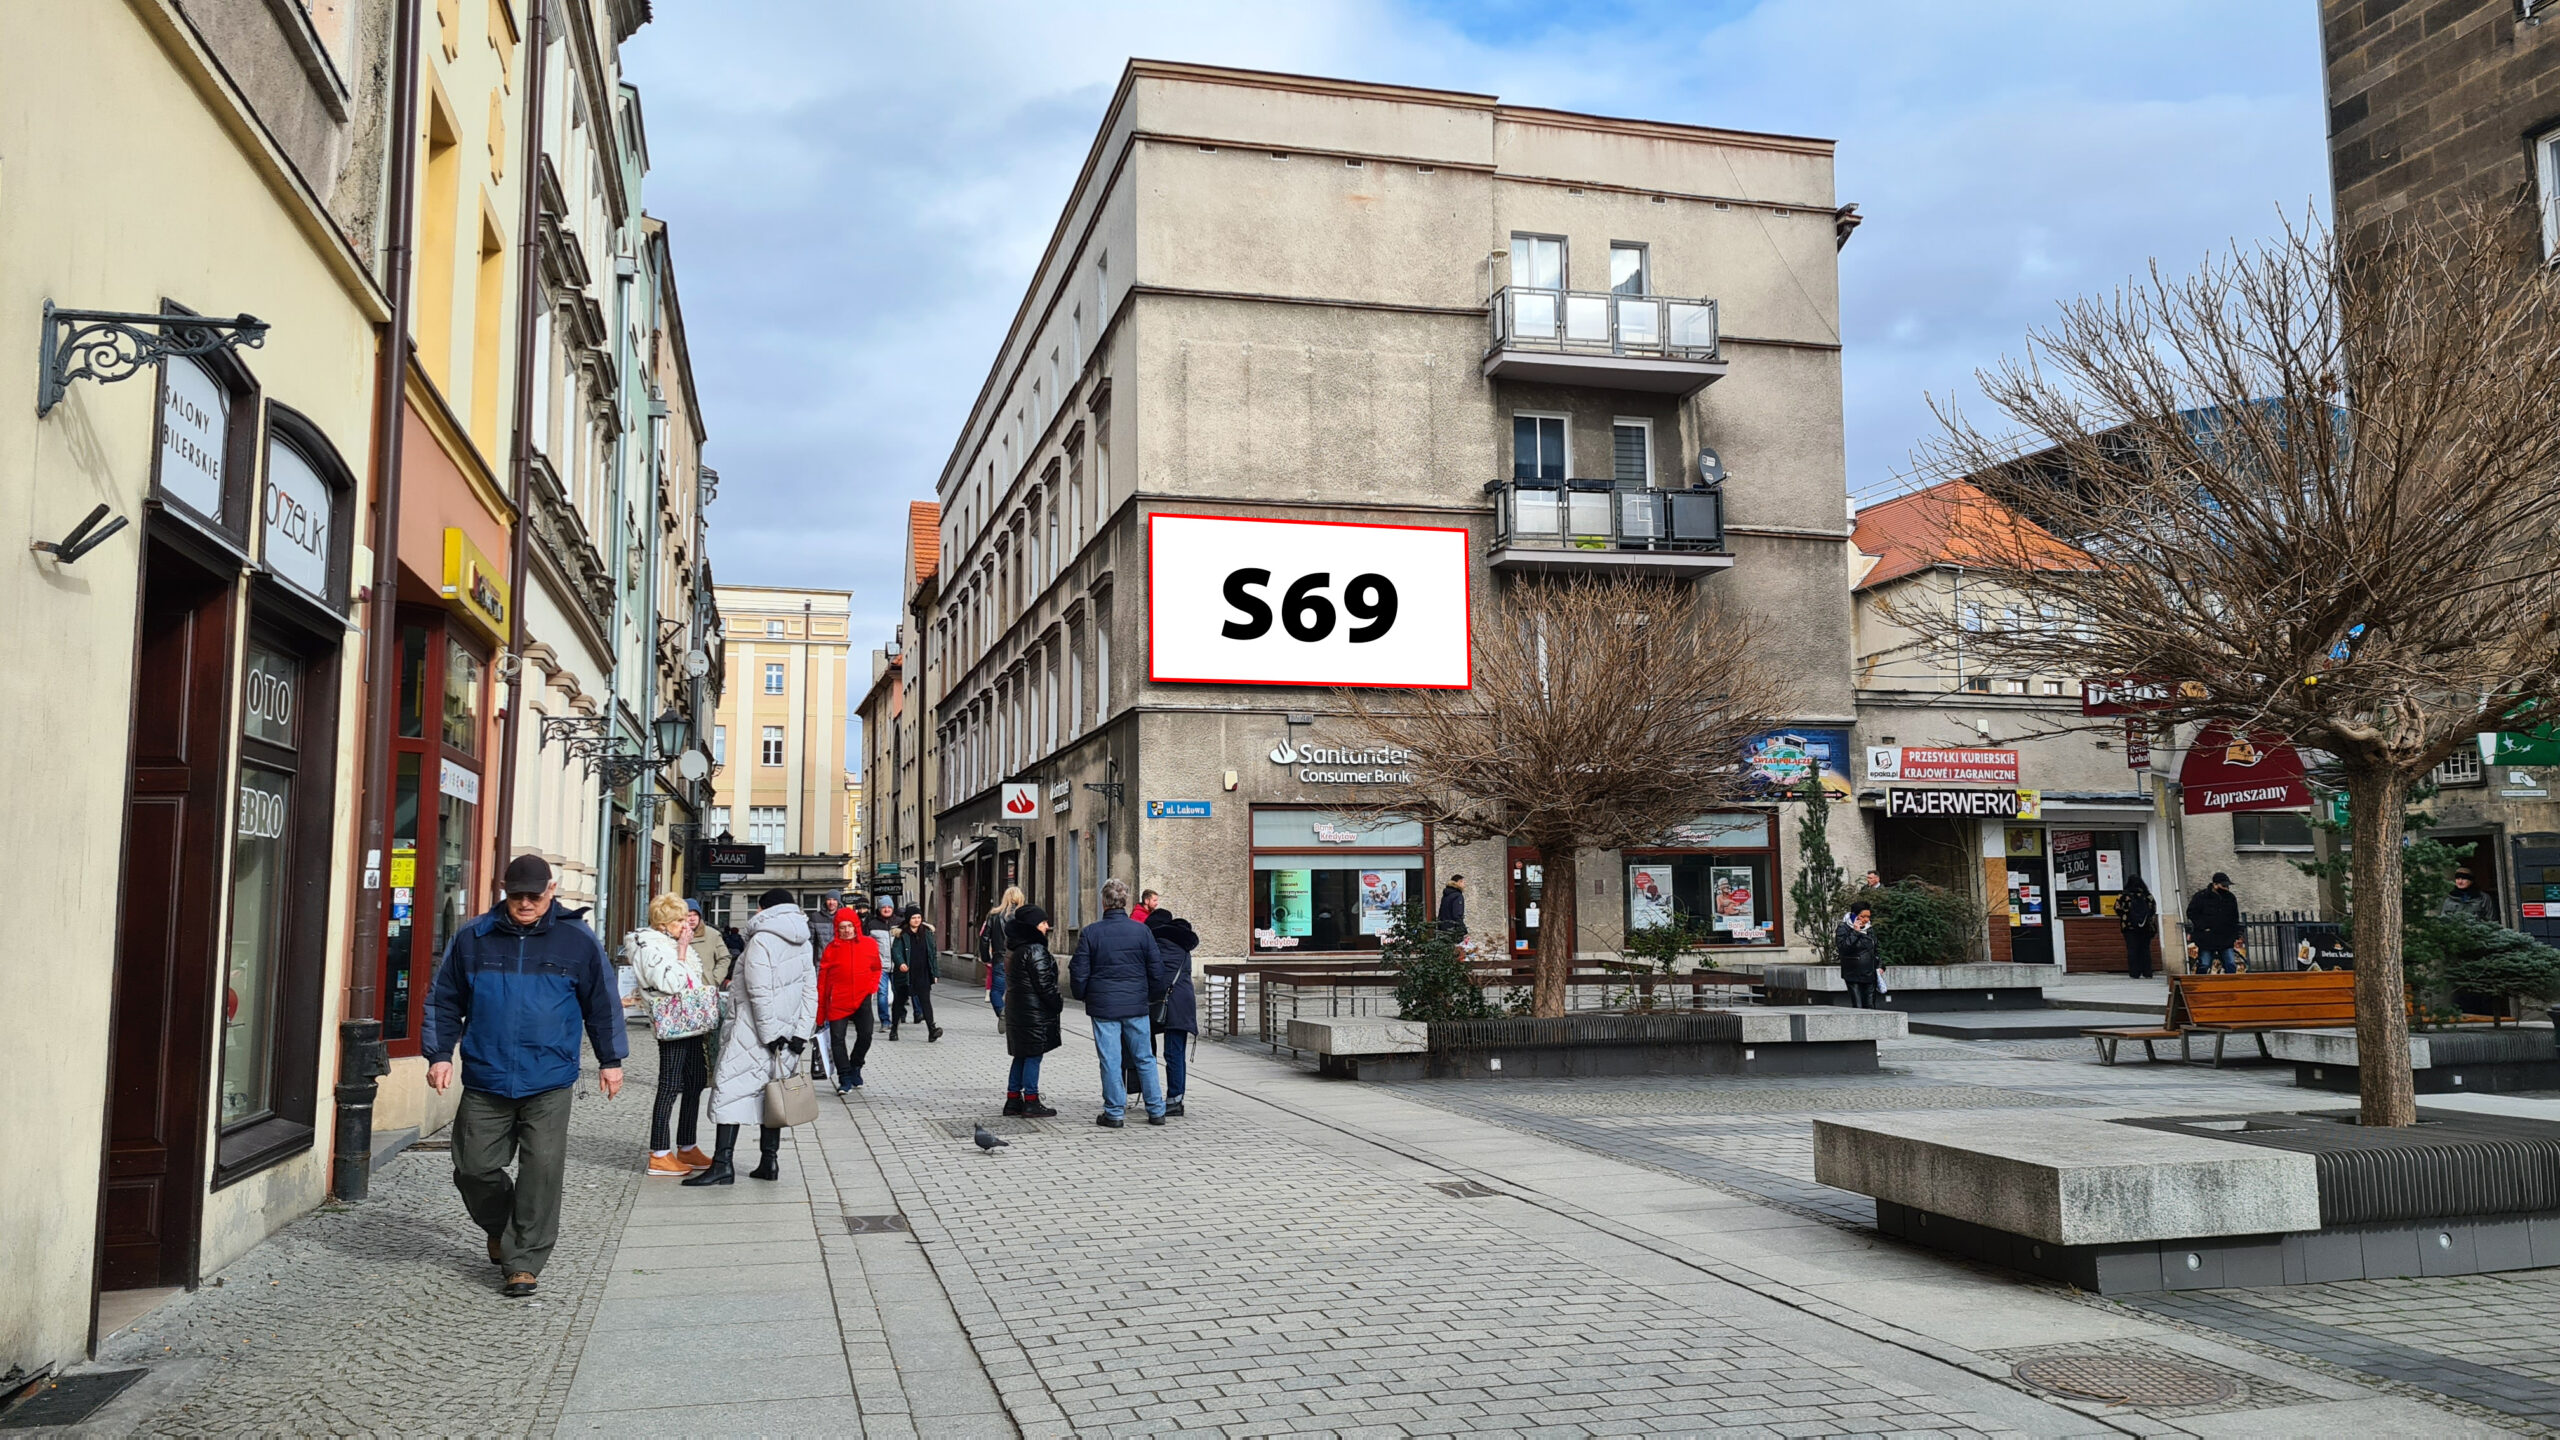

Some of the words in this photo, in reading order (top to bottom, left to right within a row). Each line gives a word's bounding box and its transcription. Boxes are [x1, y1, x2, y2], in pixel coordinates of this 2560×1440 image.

[164, 384, 210, 435] SALONY
[163, 423, 219, 481] BILERSKIE
[247, 668, 291, 726] OTO
[1300, 743, 1412, 765] Santander
[1909, 751, 1959, 763] PRZESYŁKI
[1961, 752, 2015, 765] KURIERSKIE
[1300, 768, 1372, 783] Consumer
[1374, 769, 1411, 783] Bank
[1870, 770, 1898, 779] epaka.pl
[1904, 768, 1948, 778] KRAJOWE
[1954, 769, 2016, 780] ZAGRANICZNE
[1892, 791, 2017, 815] FAJERWERKI
[2204, 785, 2289, 808] Zapraszamy
[1314, 823, 1334, 832] Bank
[1320, 832, 1356, 842] Kredytów
[1255, 930, 1275, 938] Bank
[1734, 929, 1766, 939] Kredytów
[1261, 936, 1299, 948] Kredytów
